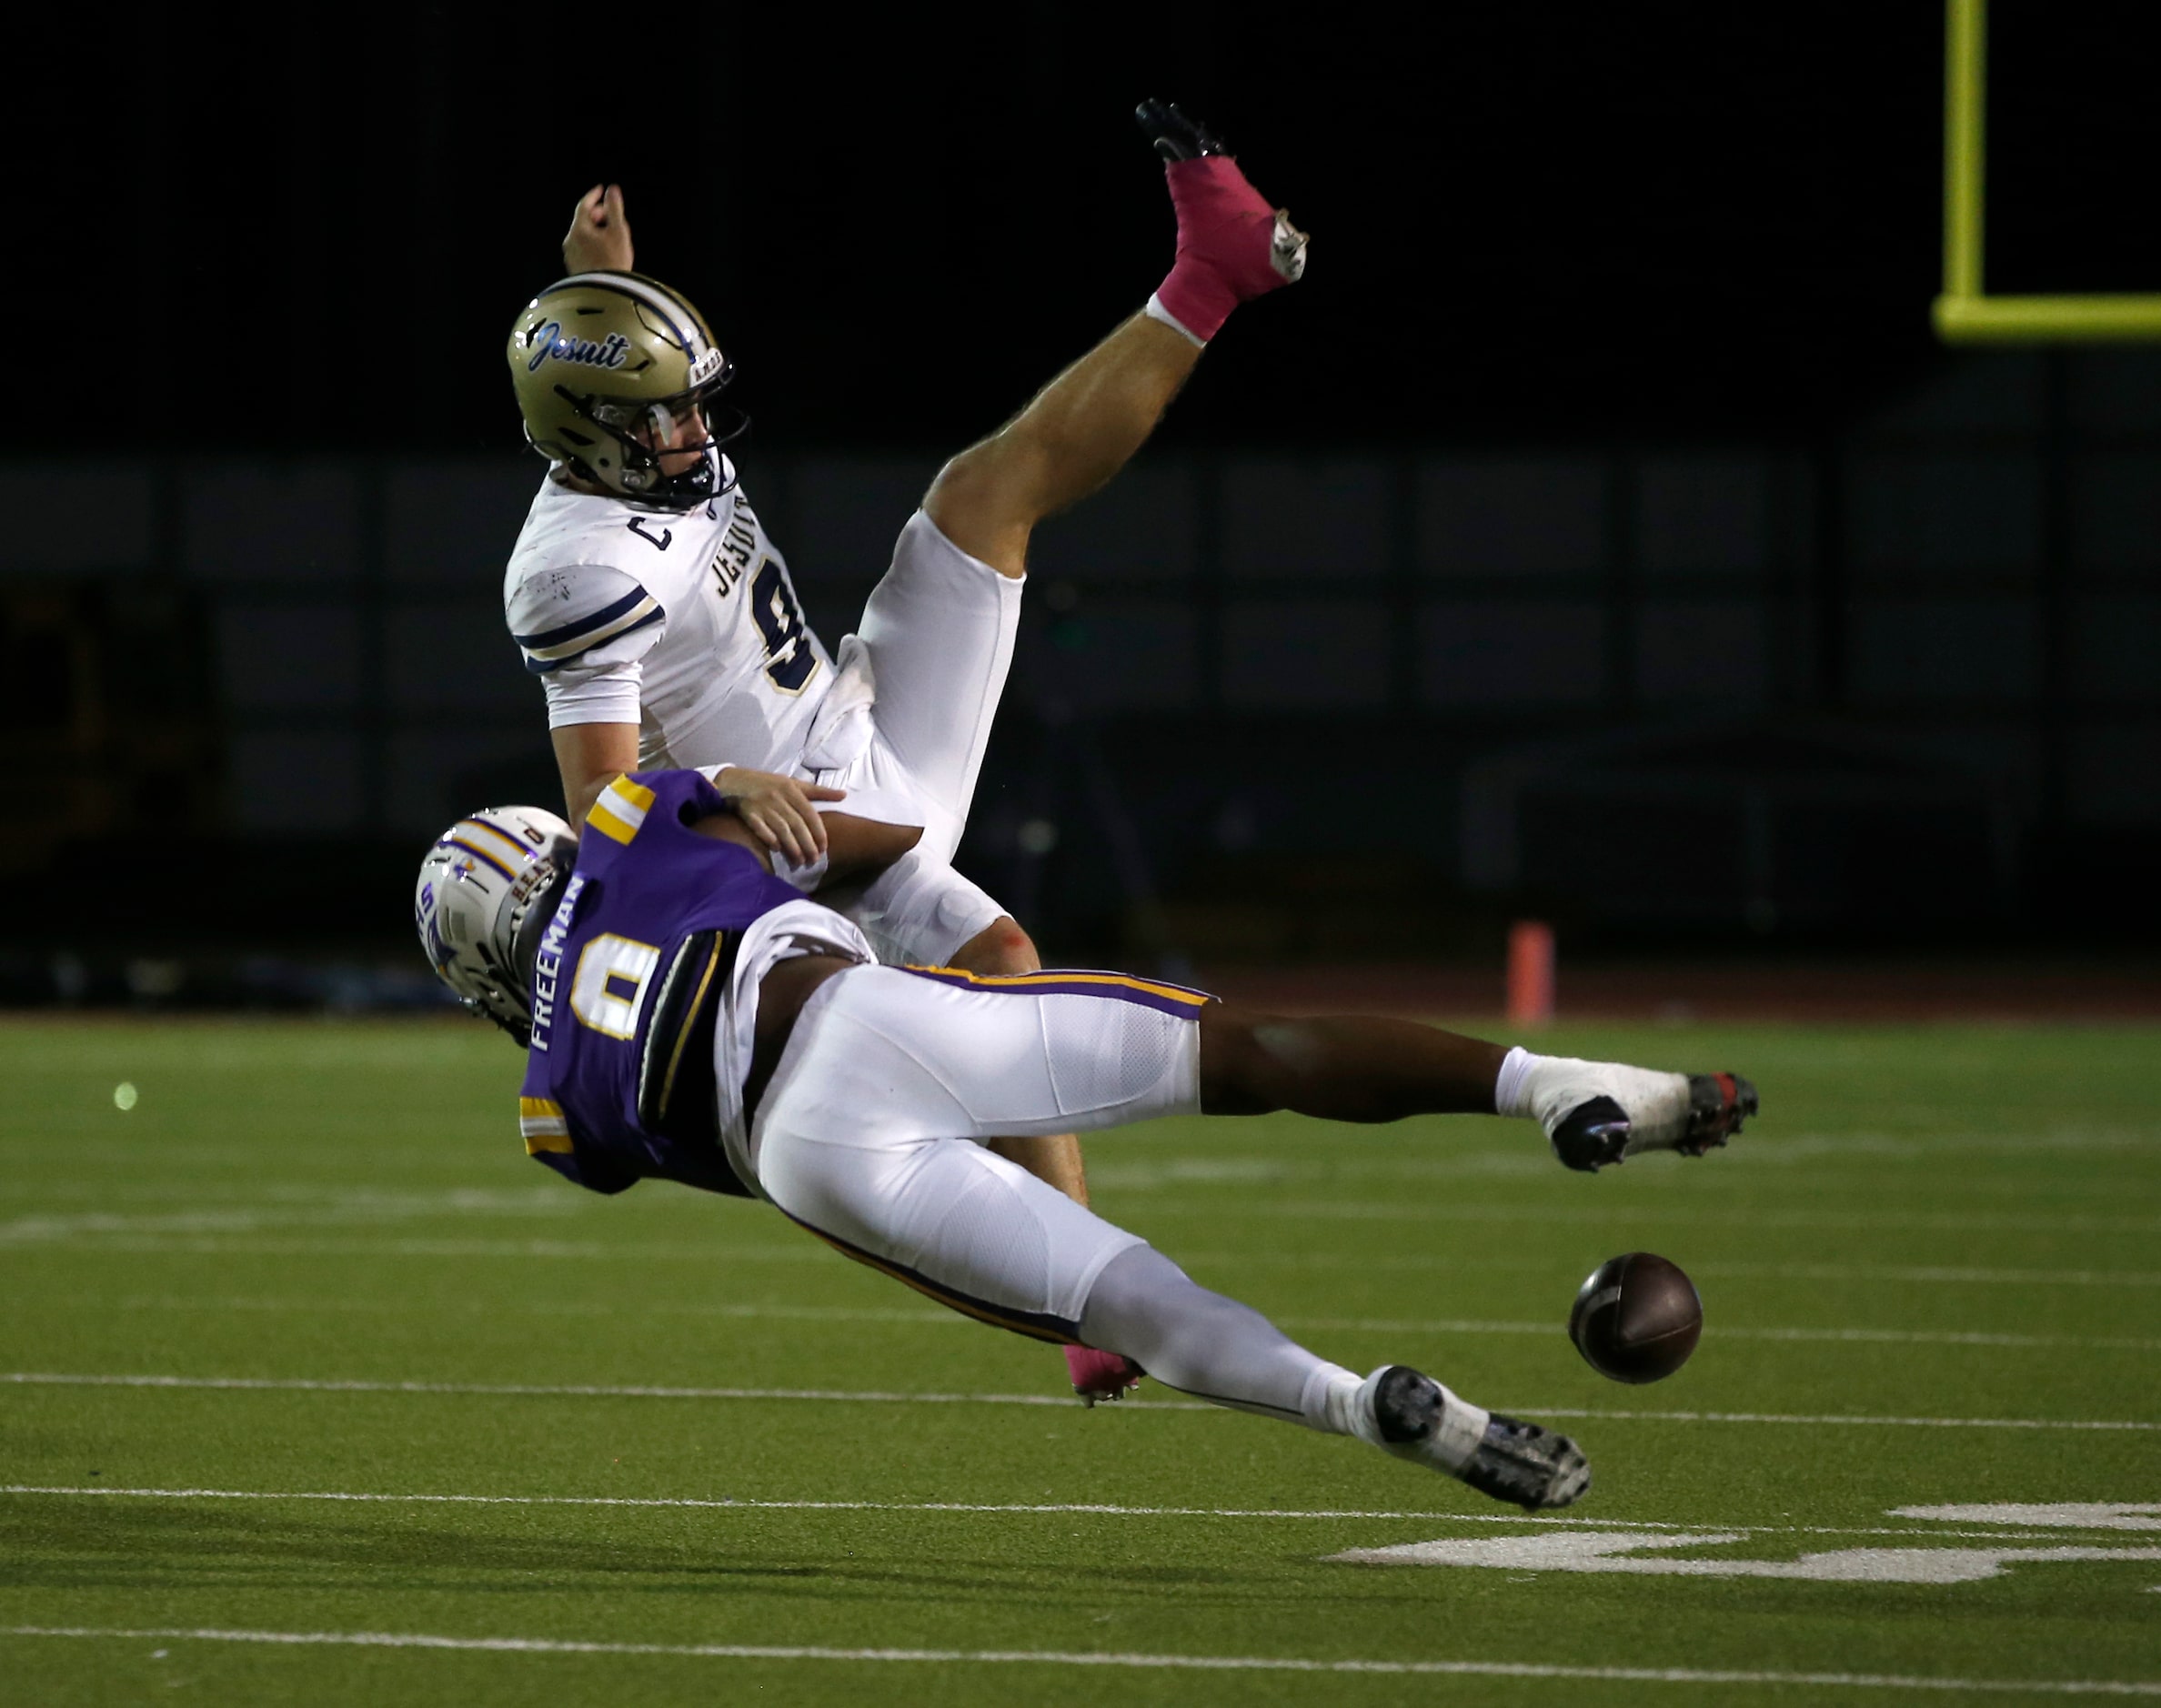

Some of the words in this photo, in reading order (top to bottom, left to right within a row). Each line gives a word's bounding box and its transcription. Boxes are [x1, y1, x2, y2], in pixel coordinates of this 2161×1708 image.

[528, 322, 631, 372] Jesuit
[627, 517, 672, 551] C
[711, 496, 756, 598] JESUIT
[748, 553, 822, 698] 9
[530, 873, 585, 1051] FREEMAN
